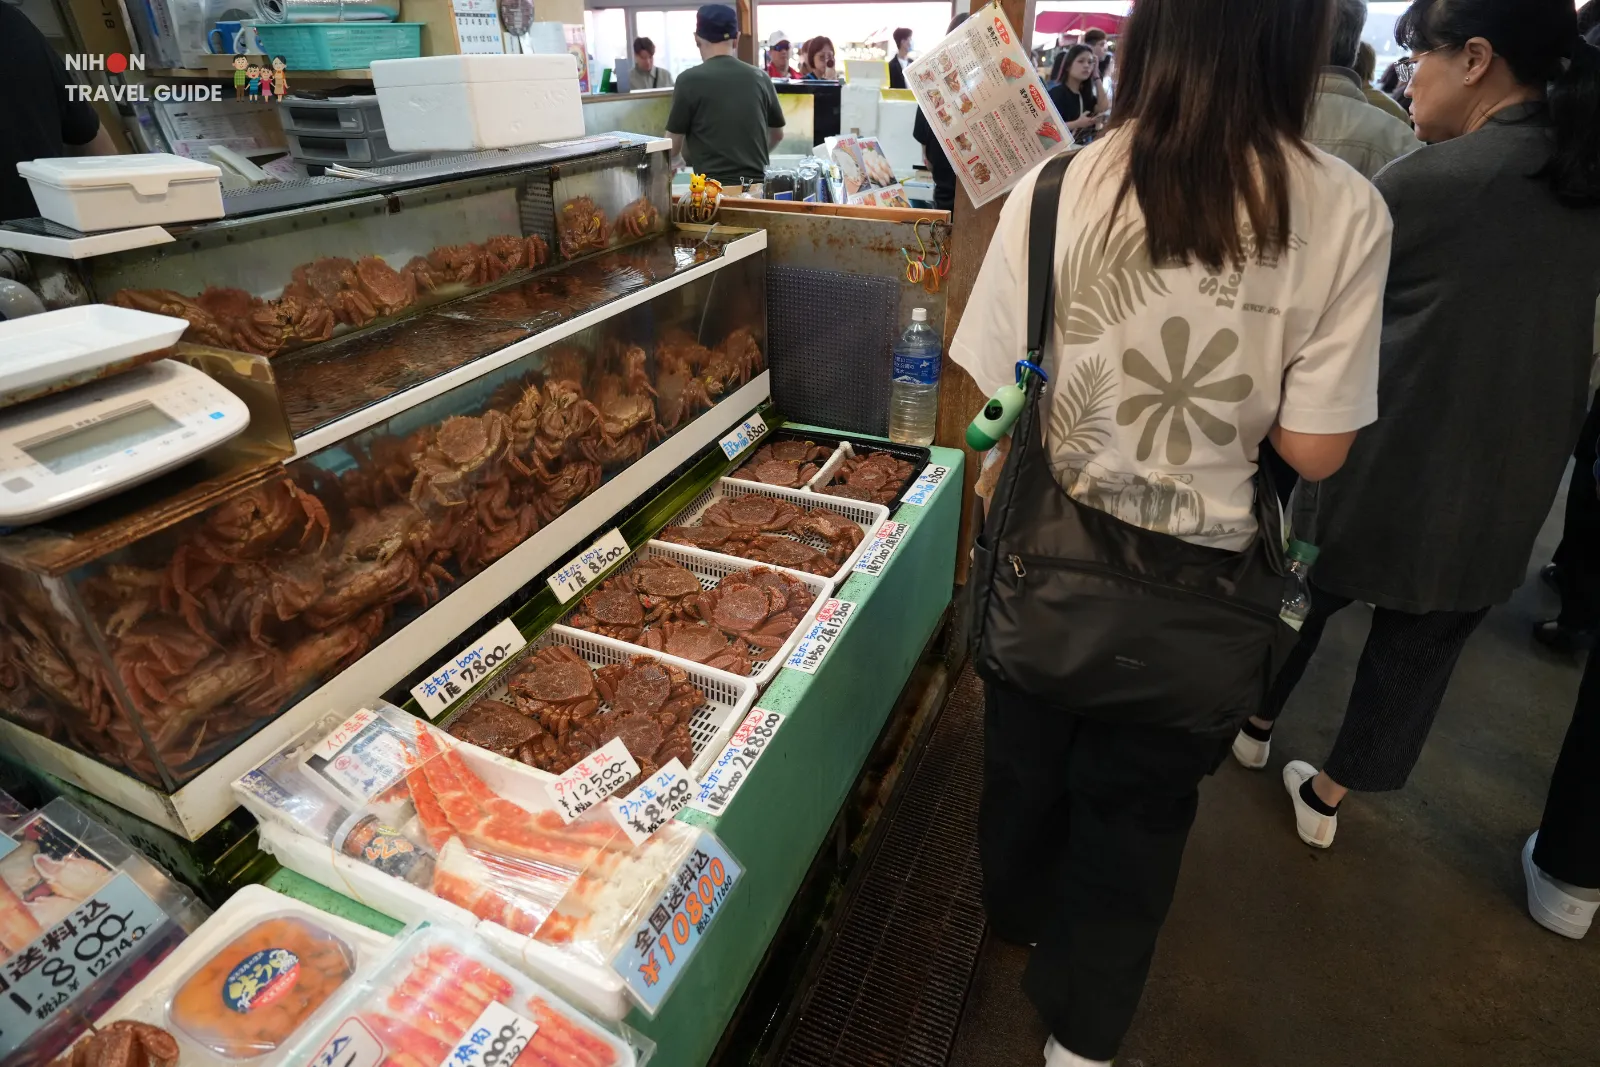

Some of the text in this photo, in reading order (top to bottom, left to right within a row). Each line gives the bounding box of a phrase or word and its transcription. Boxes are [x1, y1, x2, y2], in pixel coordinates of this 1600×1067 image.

[437, 681, 462, 705] 1尾
[593, 753, 614, 767] 5L
[657, 772, 676, 788] 2L
[634, 849, 710, 958] 全国送料込
[638, 856, 726, 988] ¥10800
